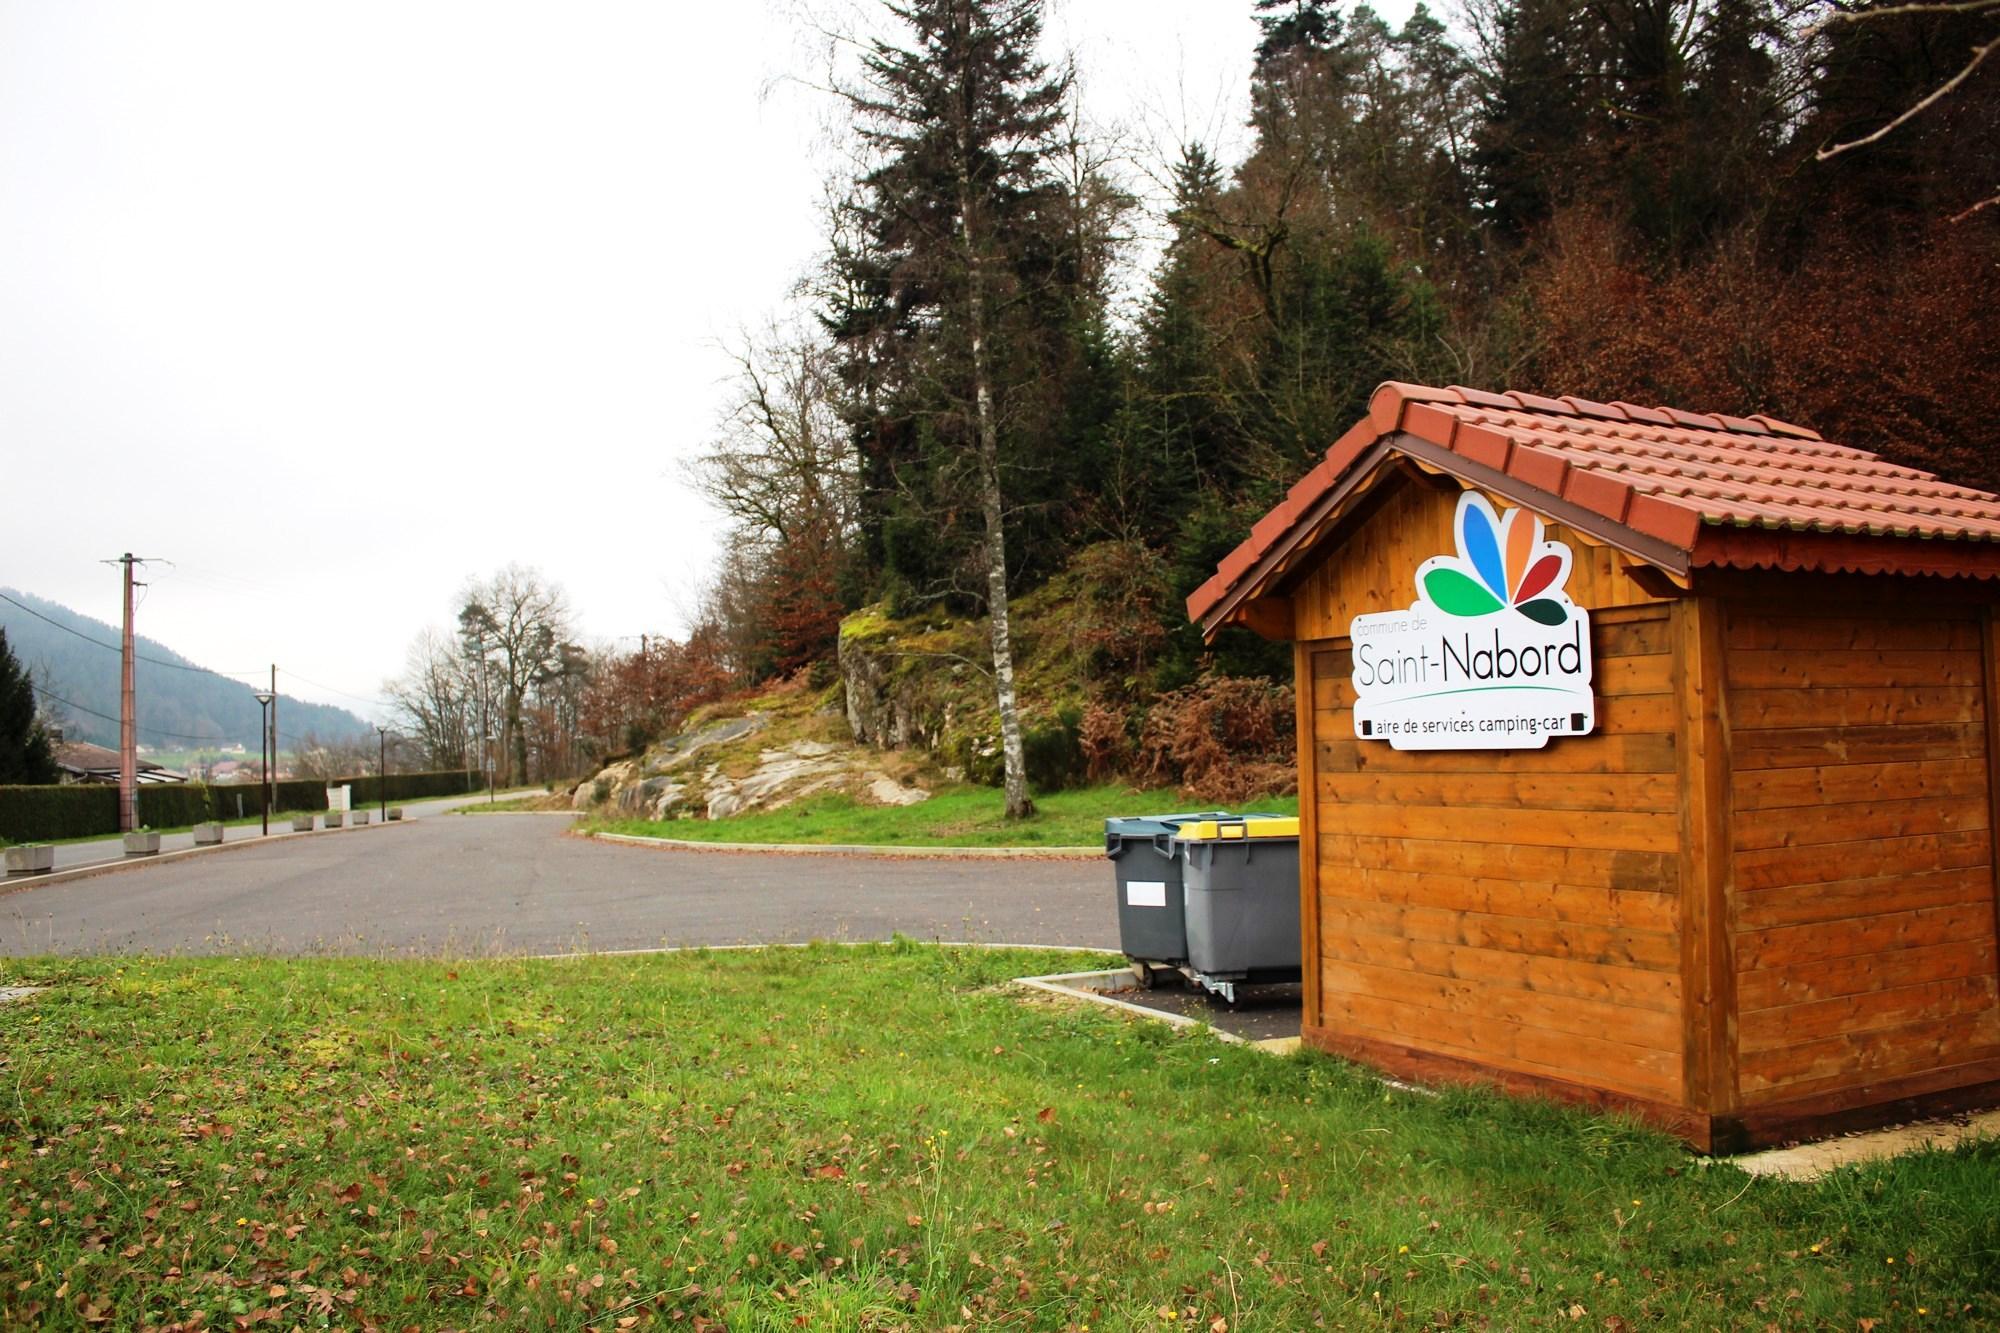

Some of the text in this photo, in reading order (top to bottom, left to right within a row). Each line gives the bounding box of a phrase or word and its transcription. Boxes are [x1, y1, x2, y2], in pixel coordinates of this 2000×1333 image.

[1357, 614, 1428, 637] commune de
[1359, 619, 1582, 686] Saint-Nabord
[1376, 714, 1566, 735] aire de services camping-car
